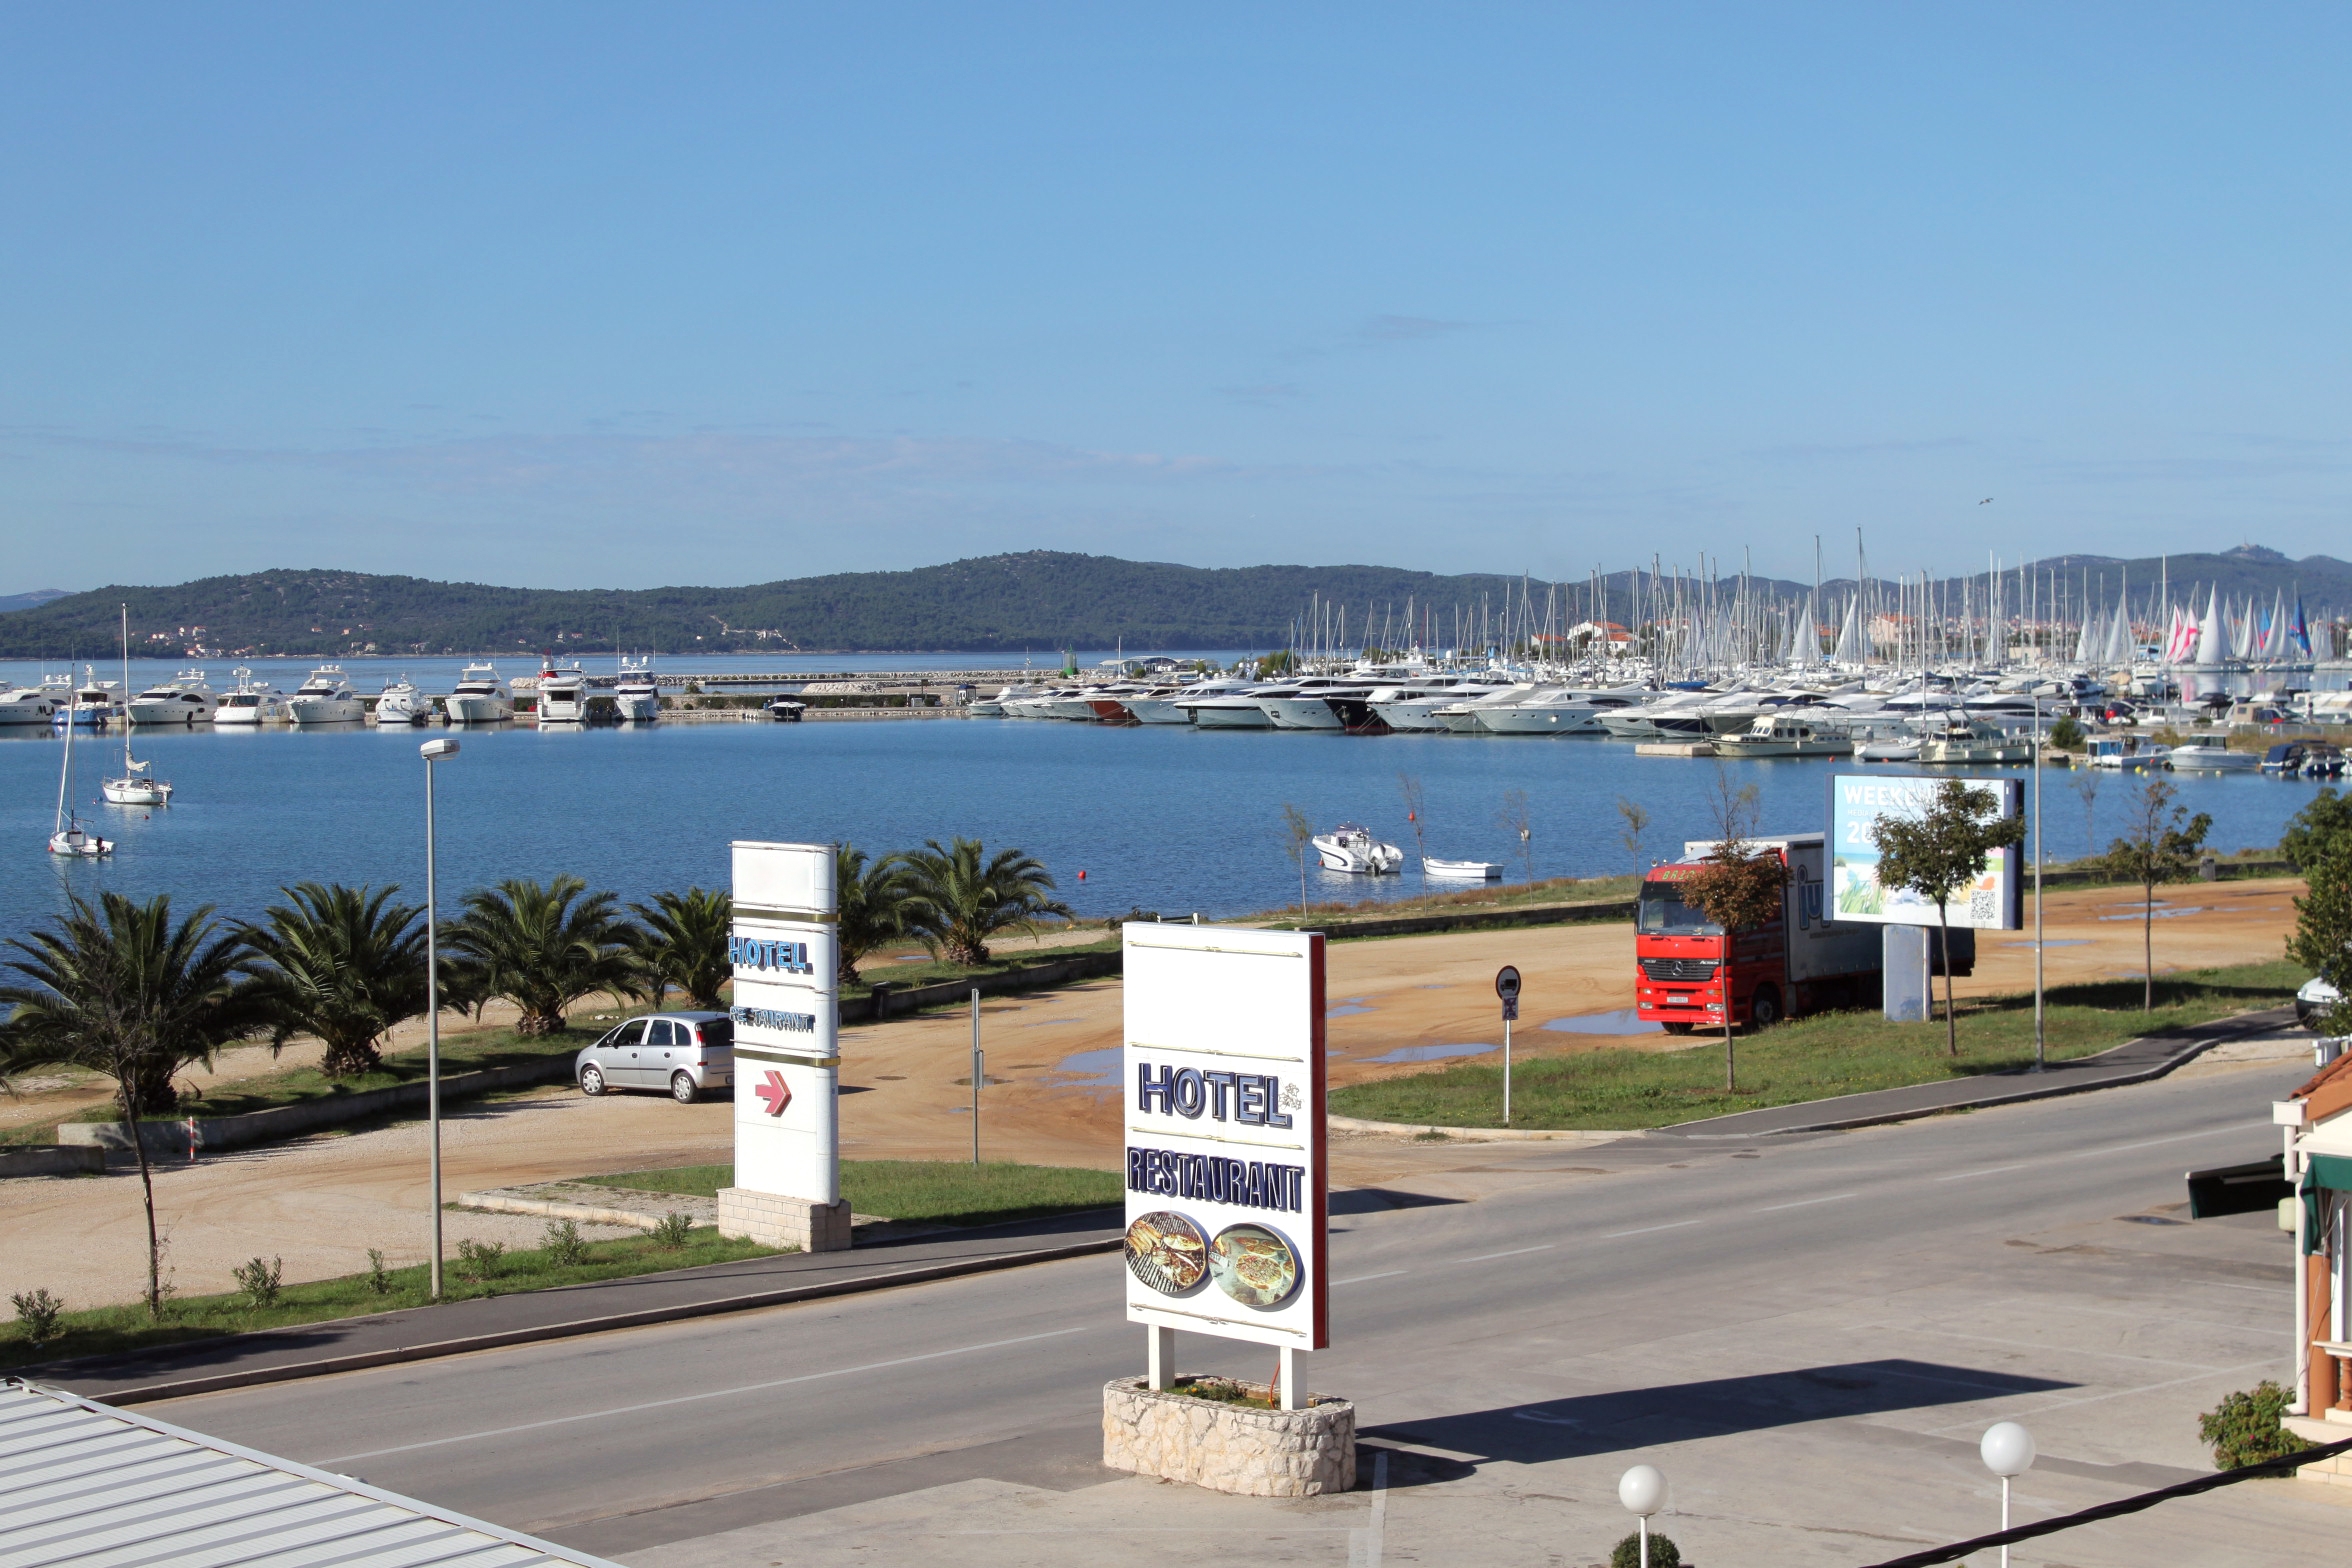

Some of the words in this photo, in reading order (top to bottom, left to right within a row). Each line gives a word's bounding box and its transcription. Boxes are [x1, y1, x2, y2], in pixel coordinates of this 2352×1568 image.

[728, 936, 807, 970] HOTEL
[1139, 1063, 1293, 1129] HOTEL
[1127, 1146, 1305, 1213] RESTAURANT
